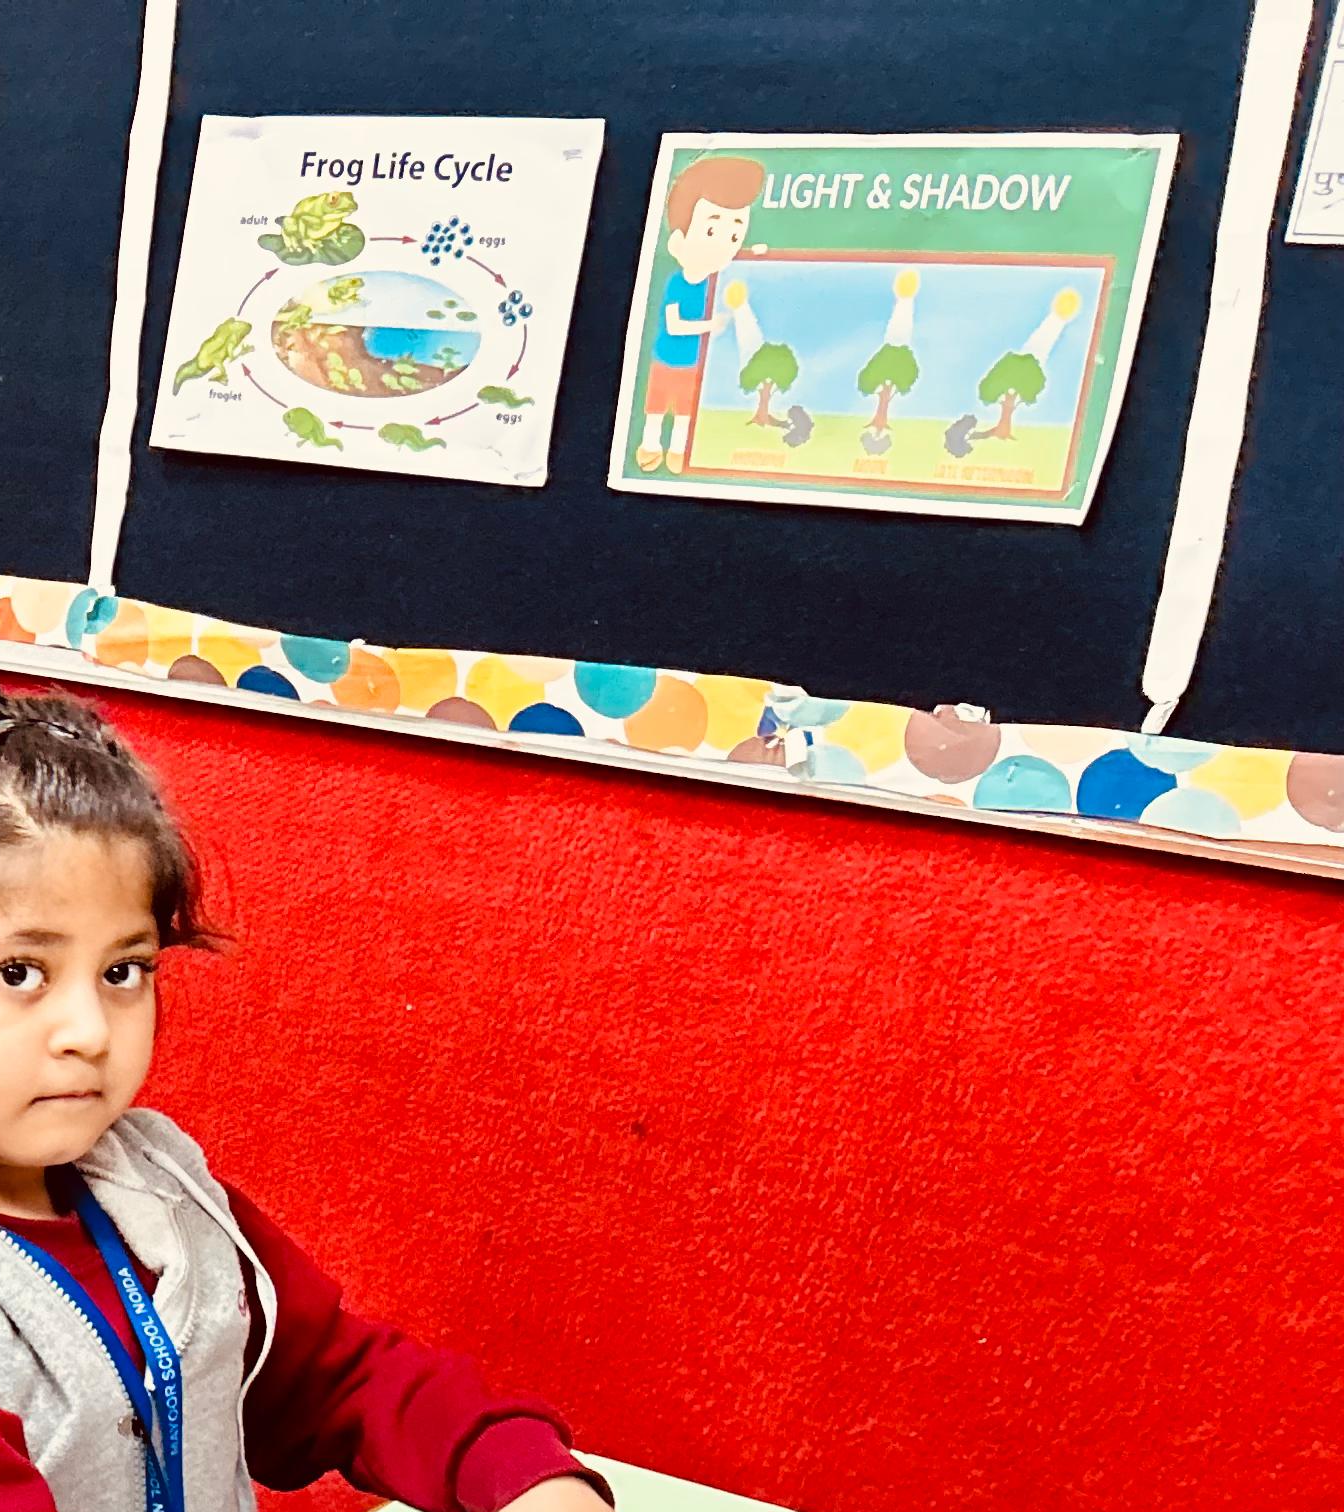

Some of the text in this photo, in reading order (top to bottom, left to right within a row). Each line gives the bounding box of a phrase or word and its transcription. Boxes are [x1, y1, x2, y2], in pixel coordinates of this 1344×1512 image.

[300, 151, 513, 189] Frog Life Cycle
[761, 172, 1072, 213] LIGHT & SHADOW
[239, 215, 269, 226] adult
[479, 236, 506, 248] eggs
[209, 390, 242, 403] froglet
[495, 413, 523, 426] eggs
[117, 1266, 179, 1458] MAYOOR SCHOOL NOIDA
